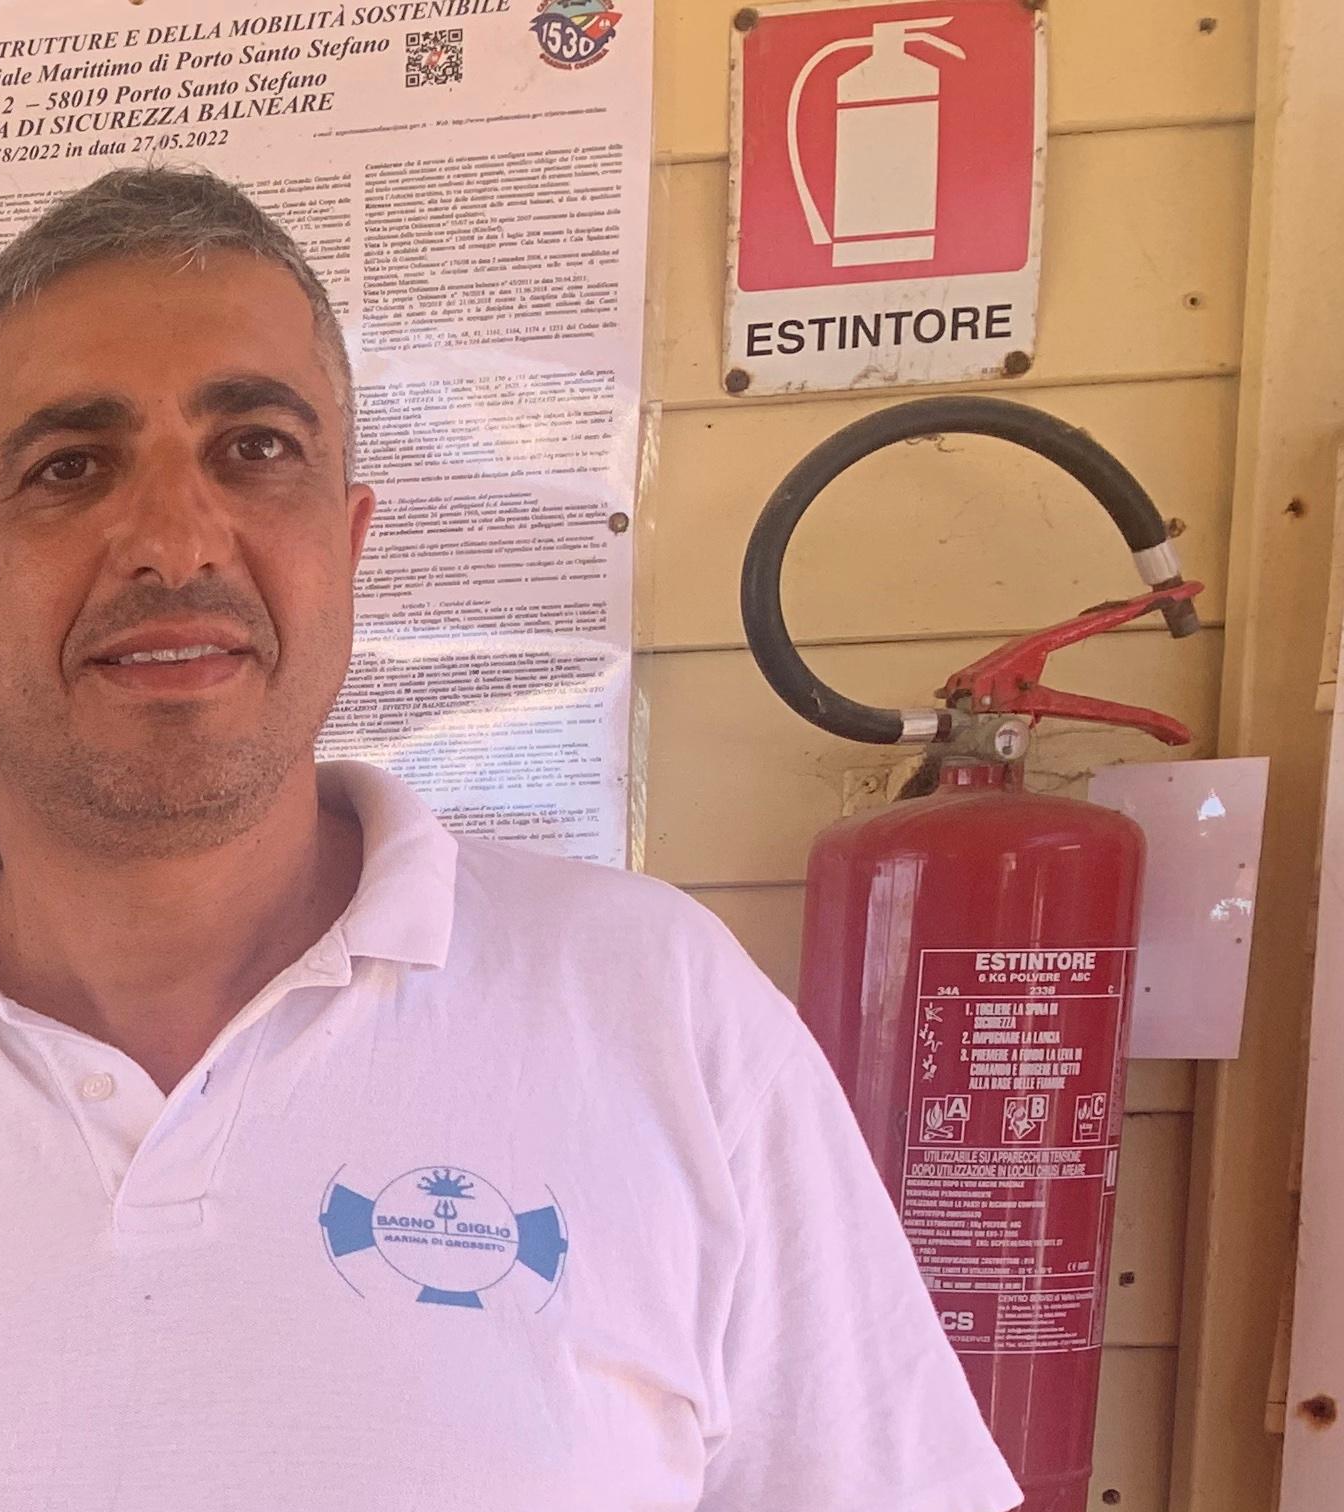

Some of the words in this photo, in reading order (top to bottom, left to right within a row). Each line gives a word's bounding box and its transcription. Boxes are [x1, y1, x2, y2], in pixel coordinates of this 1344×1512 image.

[125, 29, 140, 47] E
[145, 21, 221, 45] DELLA
[228, 4, 346, 37] MOBILITÀ
[351, 0, 512, 30] SOSTENIBILE
[542, 22, 594, 58] 1530
[38, 59, 142, 84] Marittimo
[149, 54, 168, 72] di
[175, 51, 233, 71] Porto
[239, 44, 300, 65] Santo
[307, 38, 389, 61] Stefano
[2, 96, 13, 113] 2
[46, 88, 108, 110] 58019
[115, 84, 170, 104] Porto
[177, 78, 238, 98] Santo
[245, 72, 326, 97] Stefano
[16, 118, 44, 137] DI
[50, 105, 190, 135] SICUREZZA
[197, 92, 334, 122] BALNEARE
[65, 143, 82, 158] in
[88, 140, 126, 156] data
[132, 130, 229, 152] 27.05.2022
[746, 304, 1012, 357] ESTINTORE
[975, 952, 1096, 971] ESTINTORE
[979, 973, 985, 982] 6
[989, 973, 1006, 982] KG
[1010, 973, 1060, 982] POLVERE
[1071, 972, 1091, 981] ABC
[937, 986, 960, 996] 34A
[947, 1099, 968, 1117] A
[1030, 1098, 1046, 1116] B
[1093, 1095, 1104, 1115] C
[377, 1215, 435, 1229] BAGNO
[456, 1222, 511, 1238] GIGLIO
[384, 1234, 428, 1245] MARINA
[432, 1238, 443, 1246] DI
[445, 1239, 505, 1252] GROSSETO
